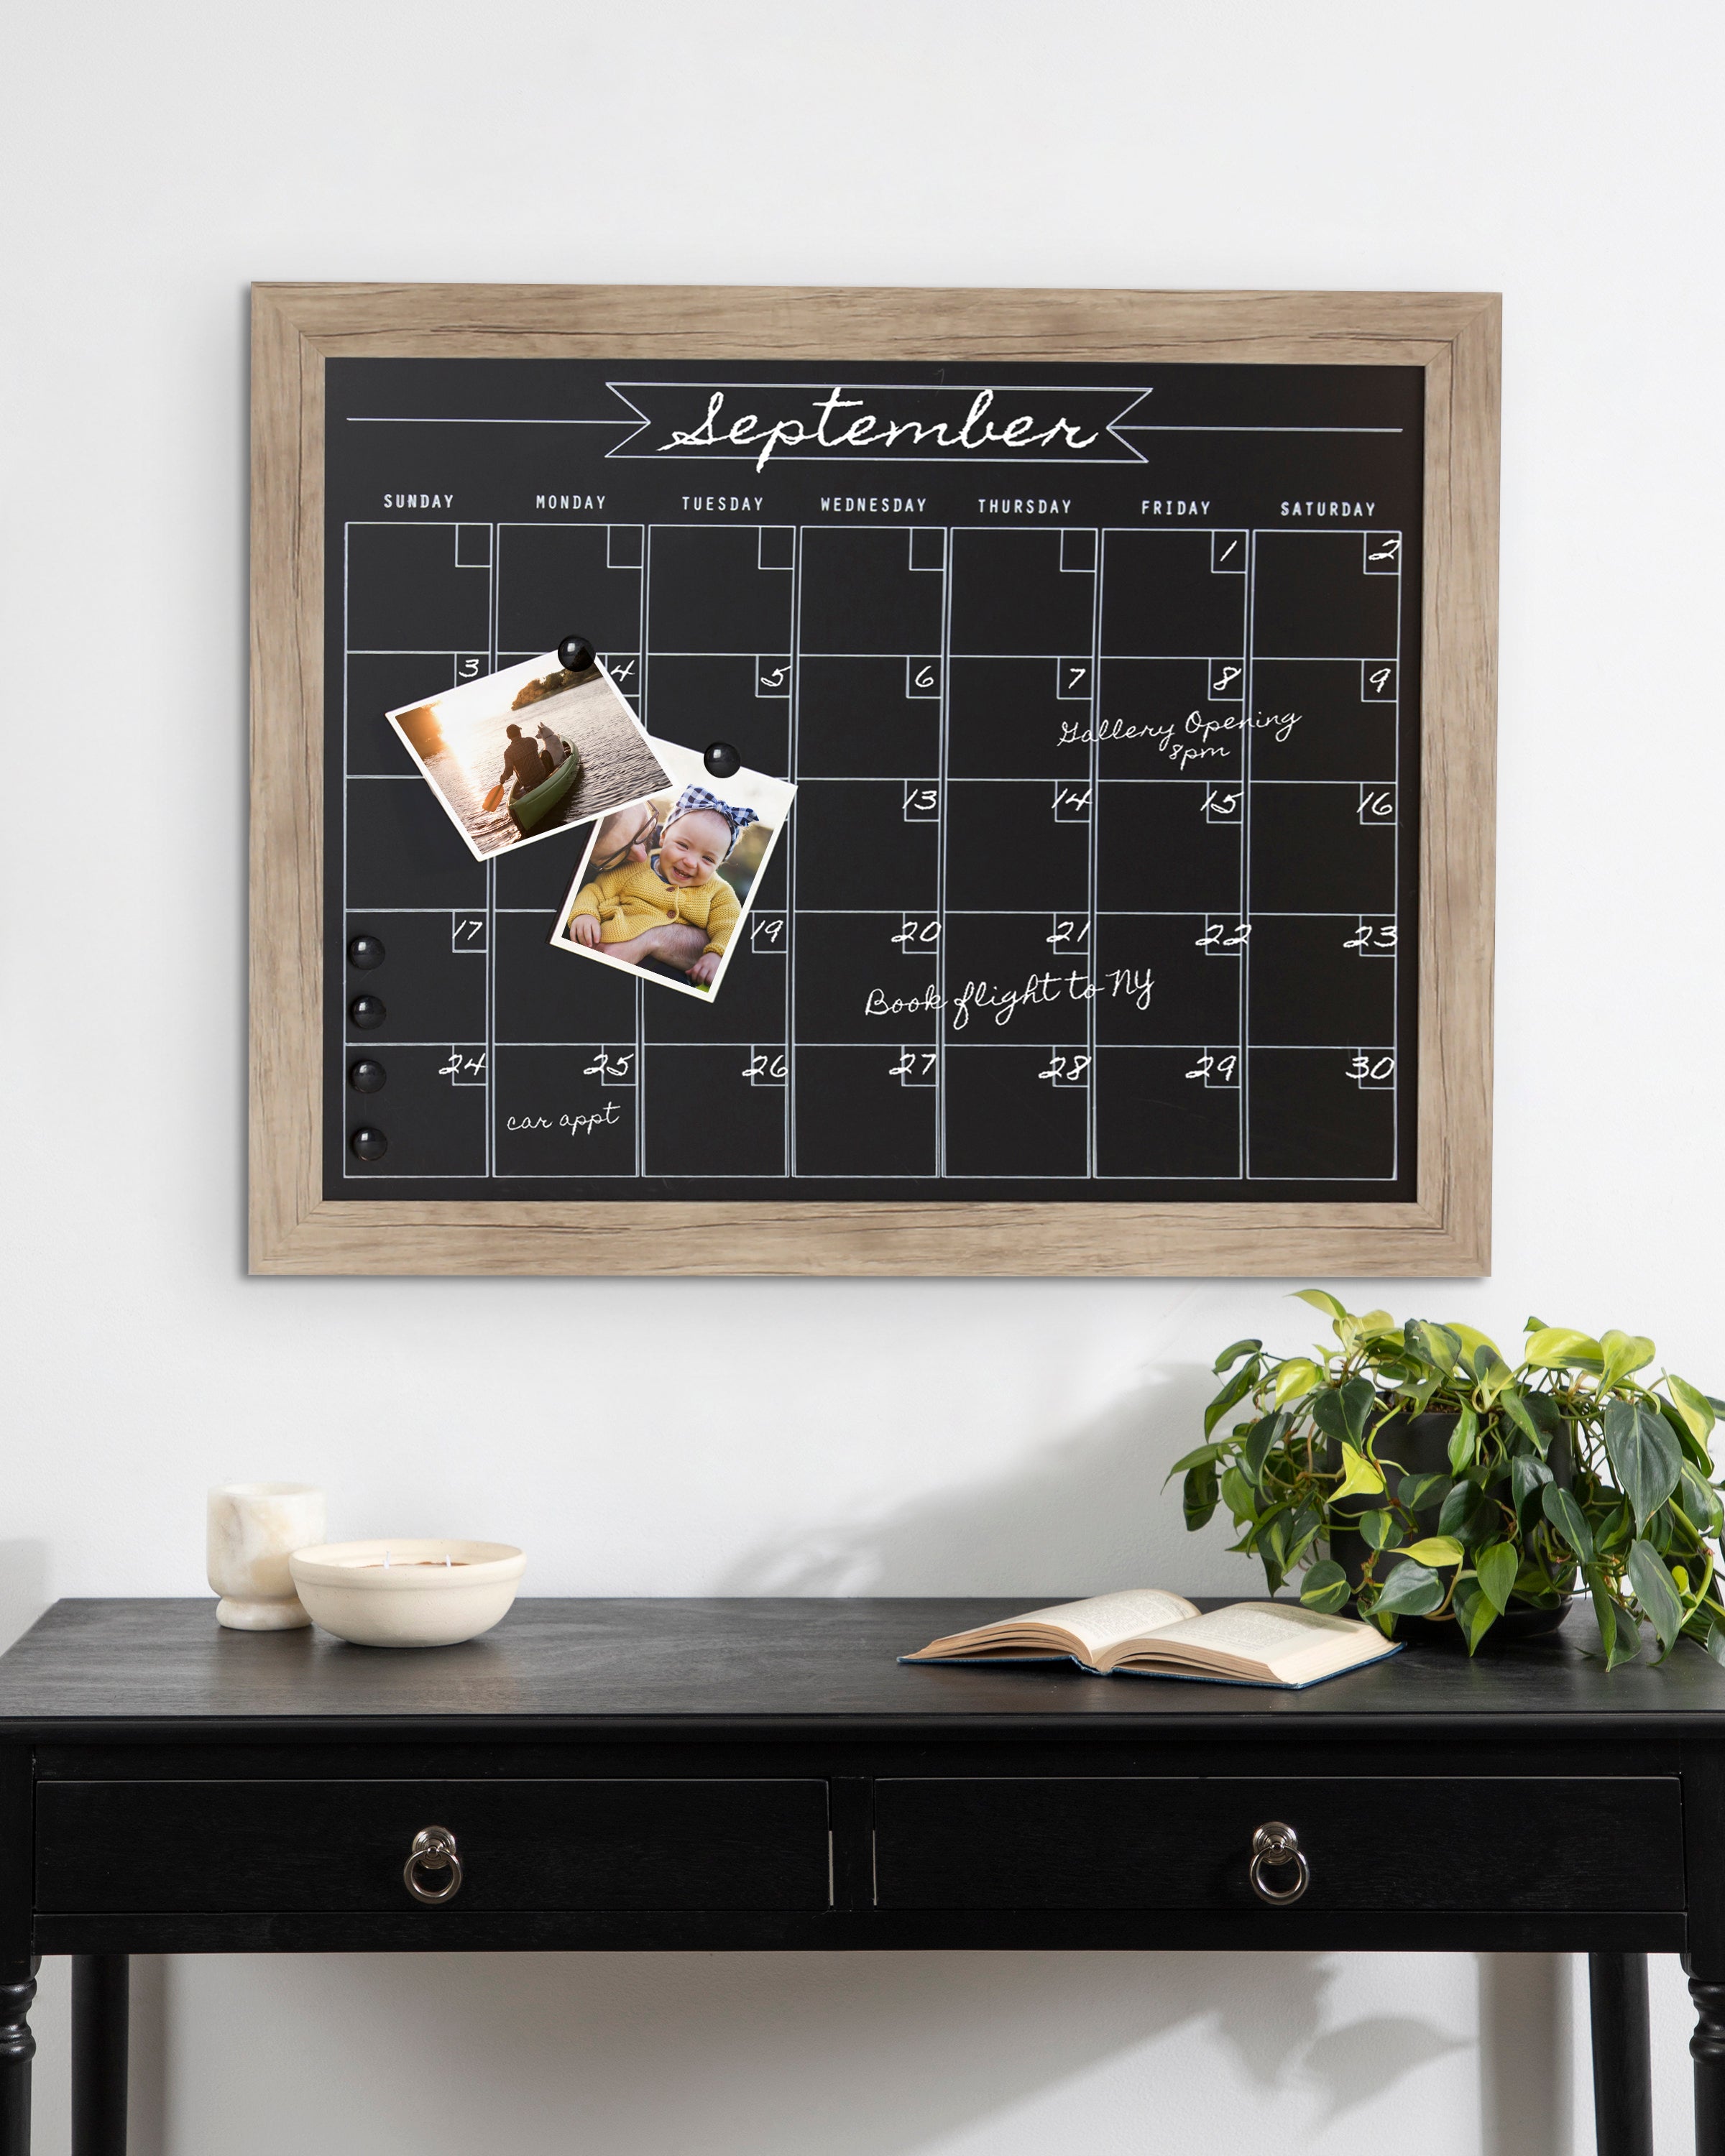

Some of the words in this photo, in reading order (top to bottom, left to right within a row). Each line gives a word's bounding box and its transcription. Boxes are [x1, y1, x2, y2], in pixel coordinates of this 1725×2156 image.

[657, 387, 1098, 473] September
[383, 494, 454, 509] SUNDAY
[535, 495, 606, 510] MONDAY
[681, 497, 763, 512] TUESDAY
[820, 497, 927, 513] WEDNESDAY
[978, 499, 1072, 515] THURSDAY
[1141, 500, 1210, 516] FRIDAY
[1280, 502, 1376, 517] SATURDAY
[1220, 540, 1237, 561] 1
[1368, 540, 1400, 560] 2
[459, 659, 479, 678] 3
[610, 660, 635, 682] 4
[760, 665, 791, 687] 5
[914, 665, 934, 688] 6
[1068, 668, 1085, 688] 7
[1213, 667, 1242, 691] 8
[1368, 669, 1392, 692] 9
[1057, 720, 1175, 751] Gallery
[1185, 710, 1302, 741] Opening
[1169, 743, 1230, 770] 8pm
[902, 789, 937, 811] 13
[1051, 788, 1093, 811] 14
[1200, 791, 1243, 814] 15
[1356, 792, 1394, 814] 16
[452, 919, 482, 940] 17
[750, 919, 784, 943] 19
[891, 921, 942, 944] 20
[1046, 921, 1091, 944] 21
[1195, 925, 1251, 946] 22
[1343, 926, 1397, 947] 23
[865, 985, 948, 1016] Book
[954, 973, 1064, 1030] flight
[1065, 970, 1104, 1000] to
[439, 1052, 488, 1075] 24
[584, 1054, 635, 1076] 25
[742, 1055, 788, 1078] 26
[889, 1054, 937, 1075] 27
[1038, 1056, 1092, 1081] 28
[1185, 1056, 1236, 1080] 29
[1346, 1057, 1394, 1079] 30
[507, 1115, 553, 1131] car
[560, 1102, 621, 1135] appt
